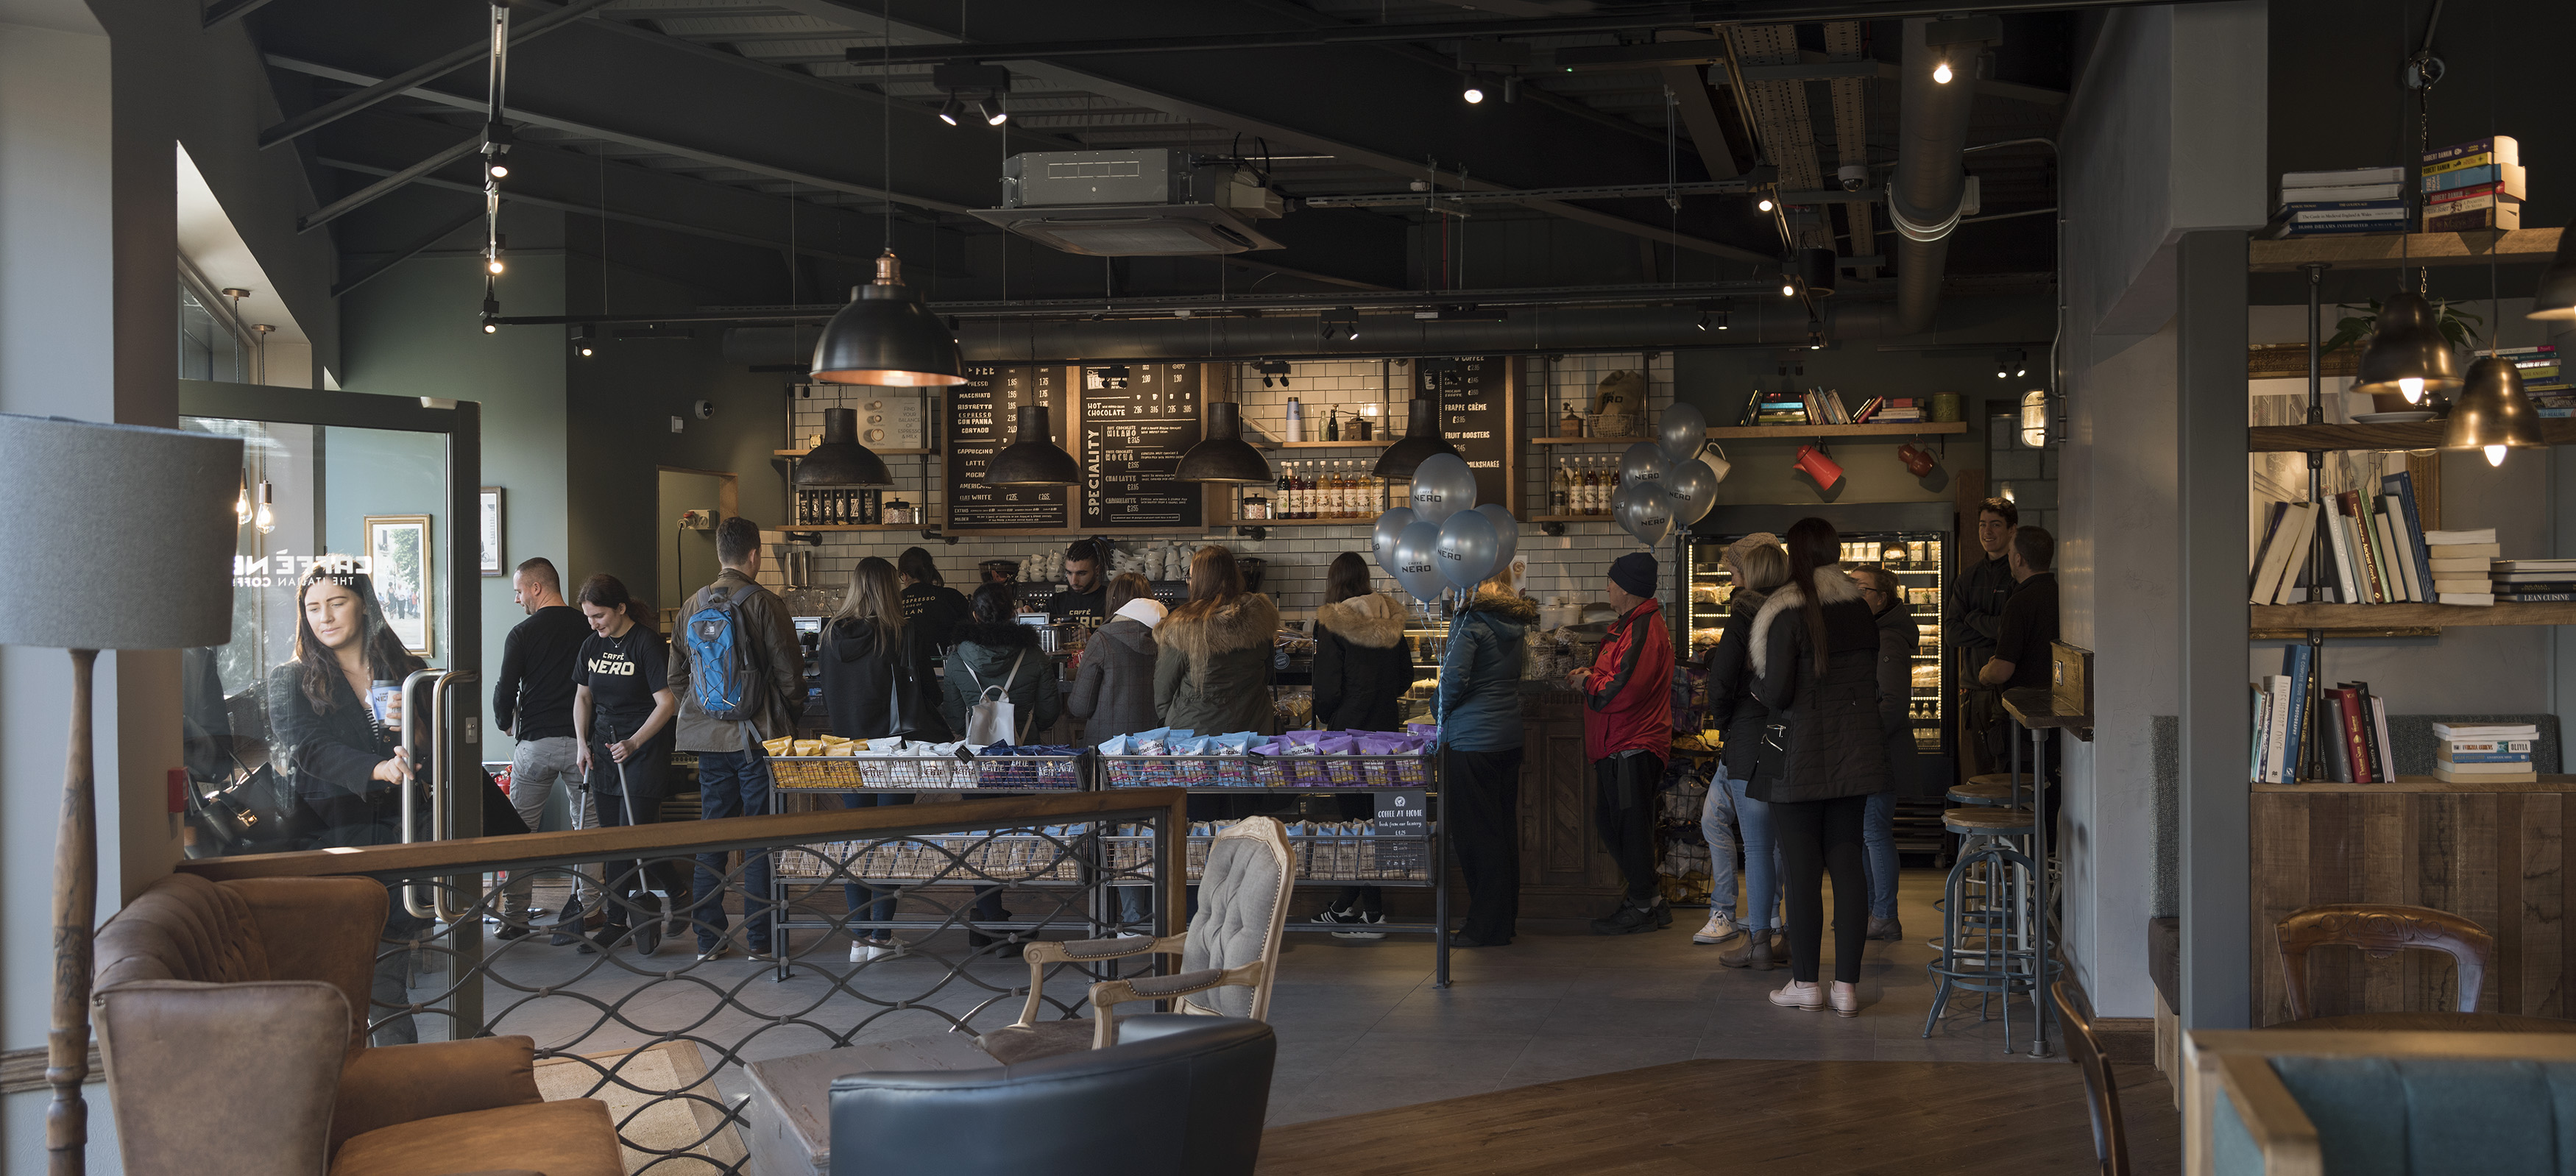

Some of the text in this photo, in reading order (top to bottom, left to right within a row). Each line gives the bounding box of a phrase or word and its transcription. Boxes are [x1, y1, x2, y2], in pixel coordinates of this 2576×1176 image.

[2423, 153, 2438, 162] ROBERT
[2423, 166, 2436, 174] ROBERT
[2432, 191, 2463, 202] ROBERT RANKIN
[1468, 402, 1487, 411] CRÈME
[1445, 431, 1460, 439] FRUIT
[1466, 460, 1500, 468] MILKSHAKES
[1088, 430, 1100, 515] SPECIALITY
[1635, 472, 1659, 481] NERO
[1669, 492, 1691, 501] NERO
[1641, 518, 1665, 526] NERO
[1372, 543, 1381, 551] RO
[1437, 549, 1462, 561] NERO
[2363, 543, 2371, 564] Ancient
[902, 596, 936, 604] ESPRESSO
[1076, 617, 1104, 628] RO
[587, 657, 635, 676] NERO
[2298, 660, 2307, 683] COMPLETE
[2280, 681, 2289, 702] JAMES
[2292, 704, 2301, 736] PHOTOGRAPHY
[2366, 726, 2374, 748] Almanac
[1378, 810, 1395, 818] COFFEE
